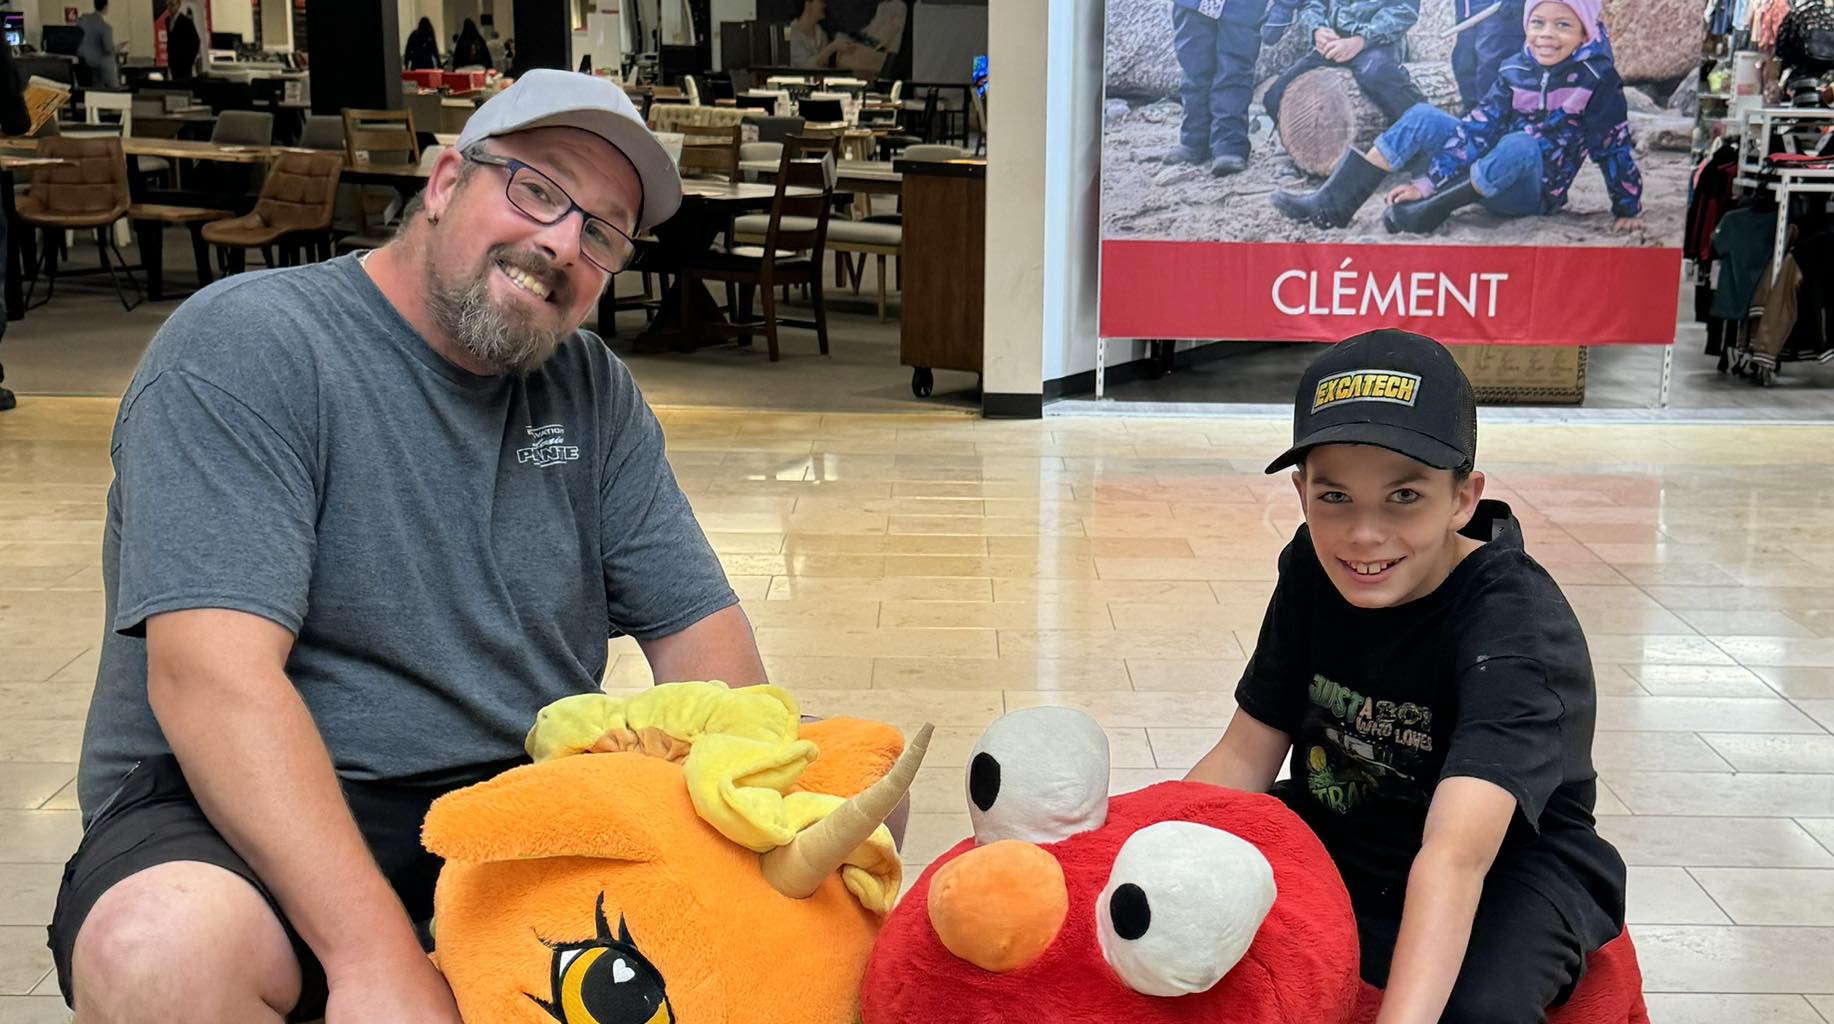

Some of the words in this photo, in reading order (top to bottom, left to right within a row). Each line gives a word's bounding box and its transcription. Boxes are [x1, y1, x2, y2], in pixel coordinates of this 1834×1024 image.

[1271, 257, 1509, 318] CLÉMENT
[1314, 374, 1415, 406] EXCATECH
[1358, 697, 1373, 720] A
